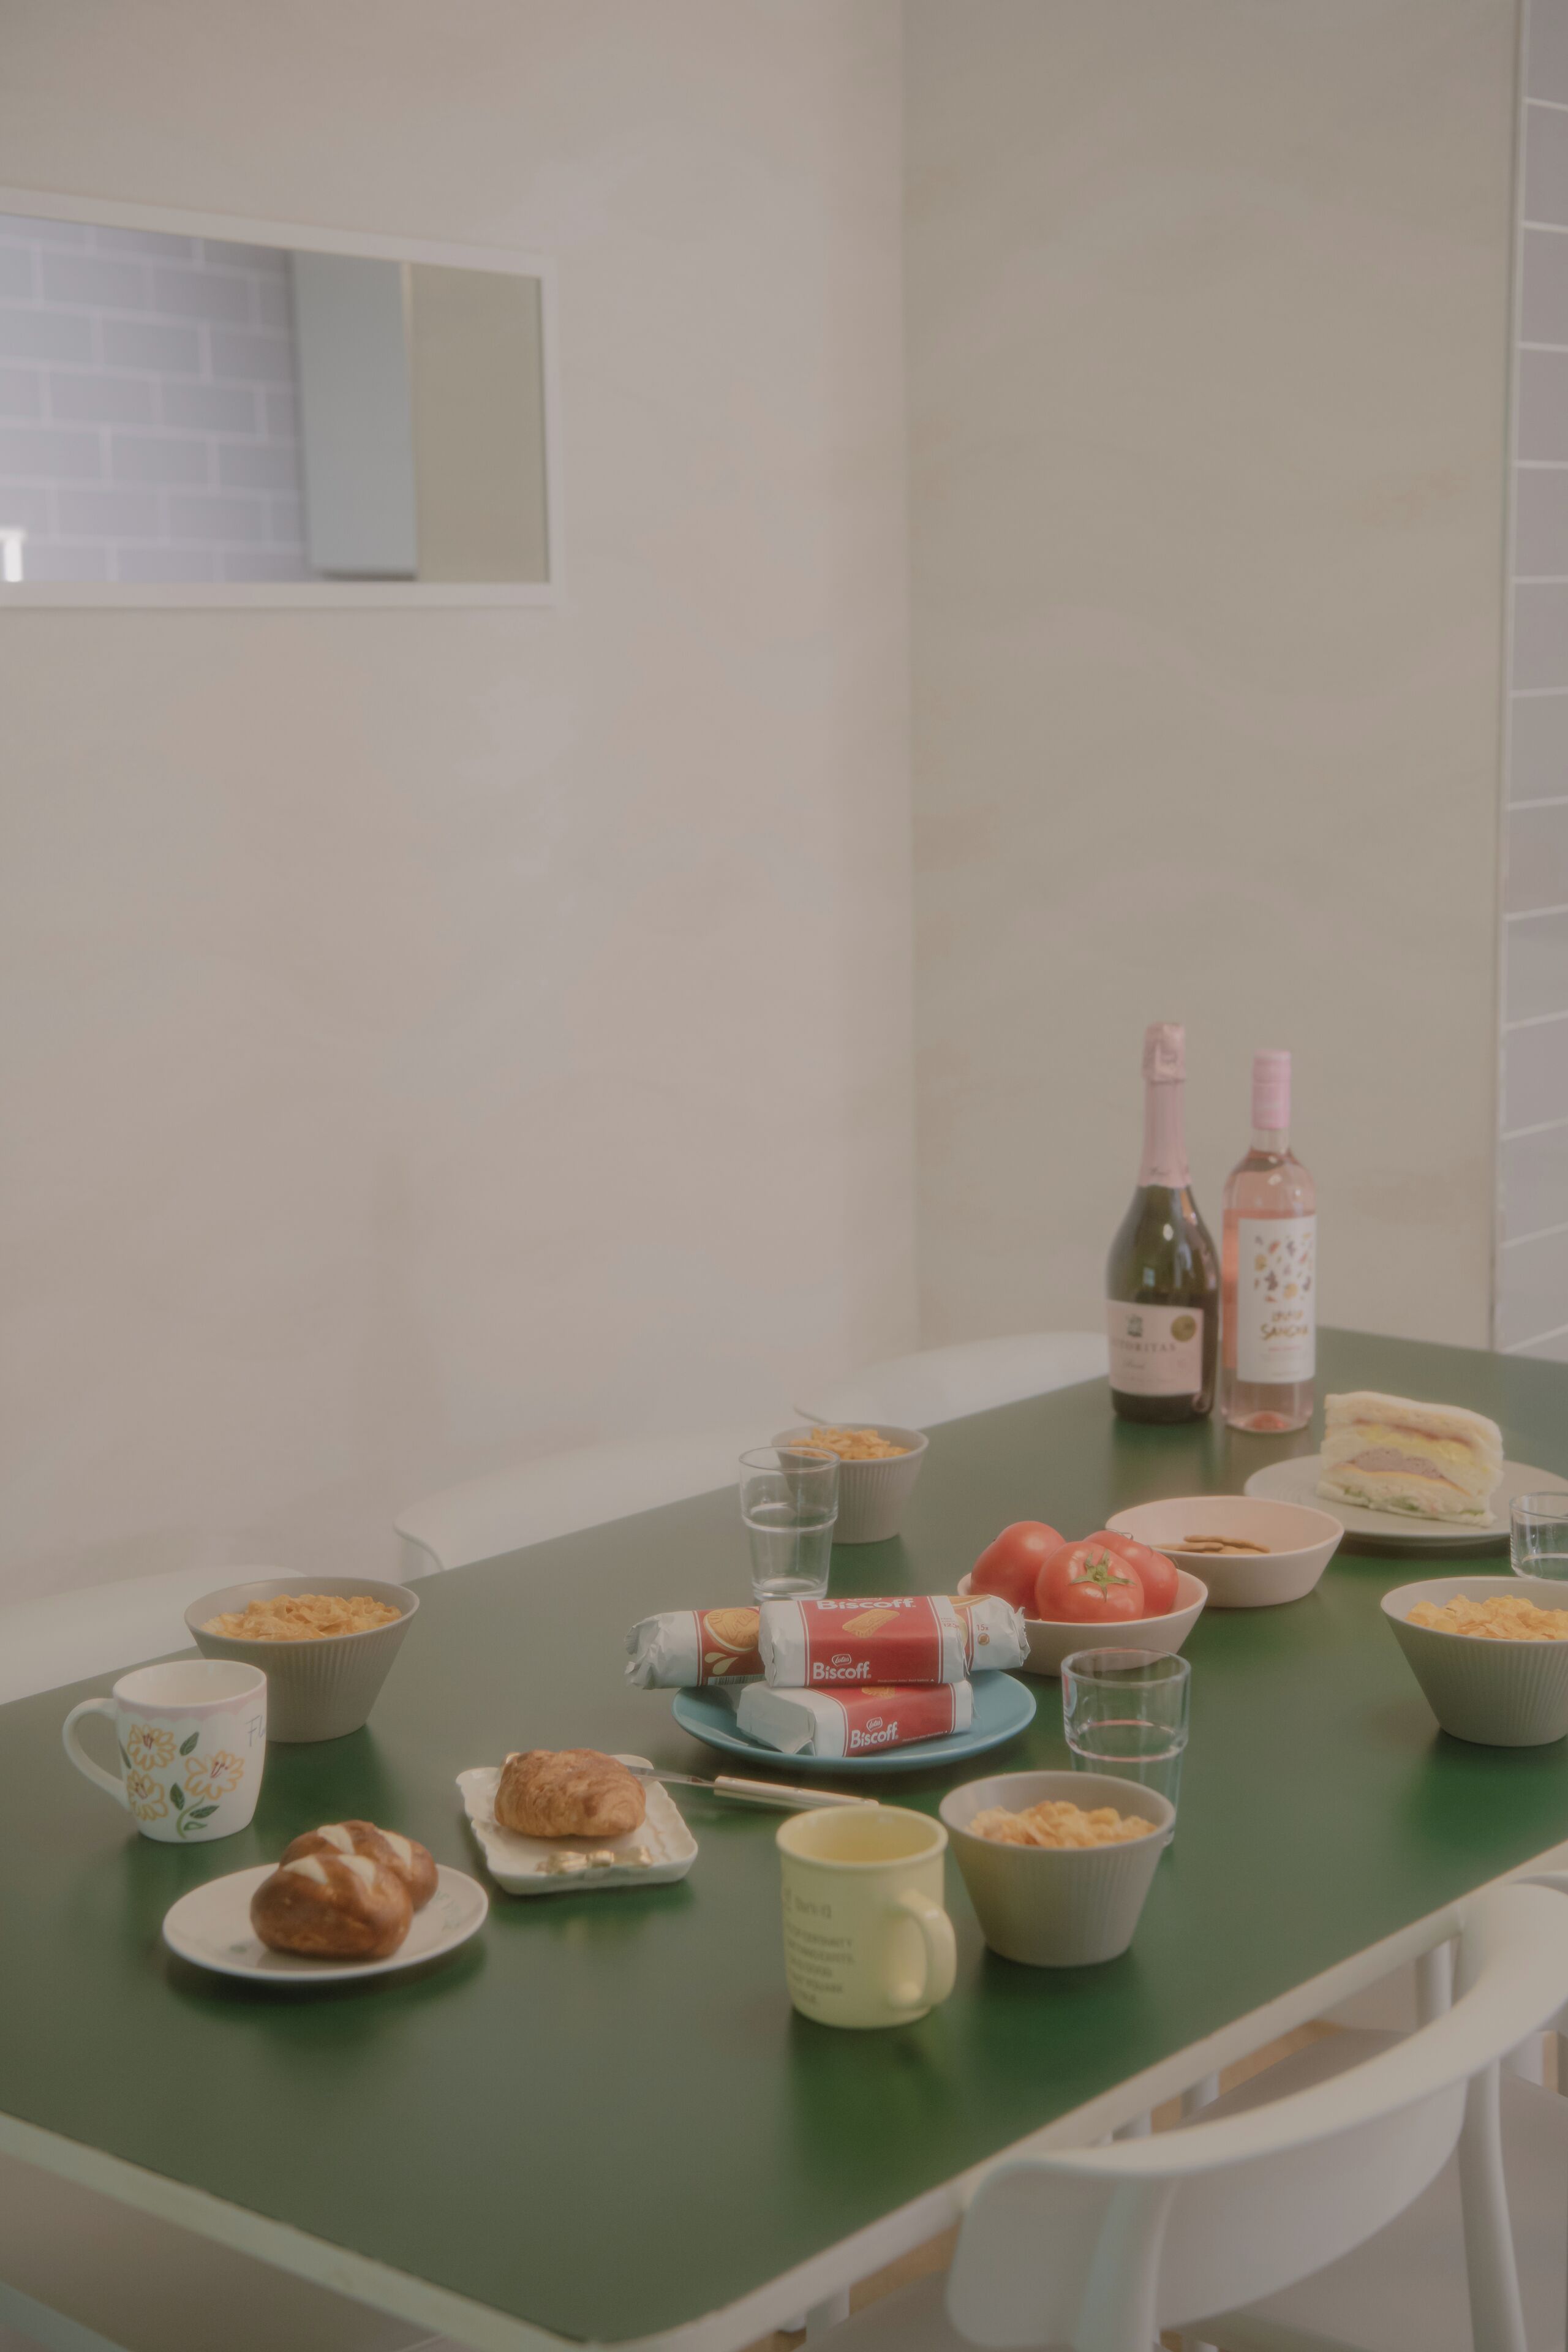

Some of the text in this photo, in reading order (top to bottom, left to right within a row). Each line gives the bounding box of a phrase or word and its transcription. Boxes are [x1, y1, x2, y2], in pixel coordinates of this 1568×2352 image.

[816, 1598, 915, 1610] Biscoff
[813, 1660, 870, 1679] Biscoff
[850, 1721, 898, 1749] Biscoff
